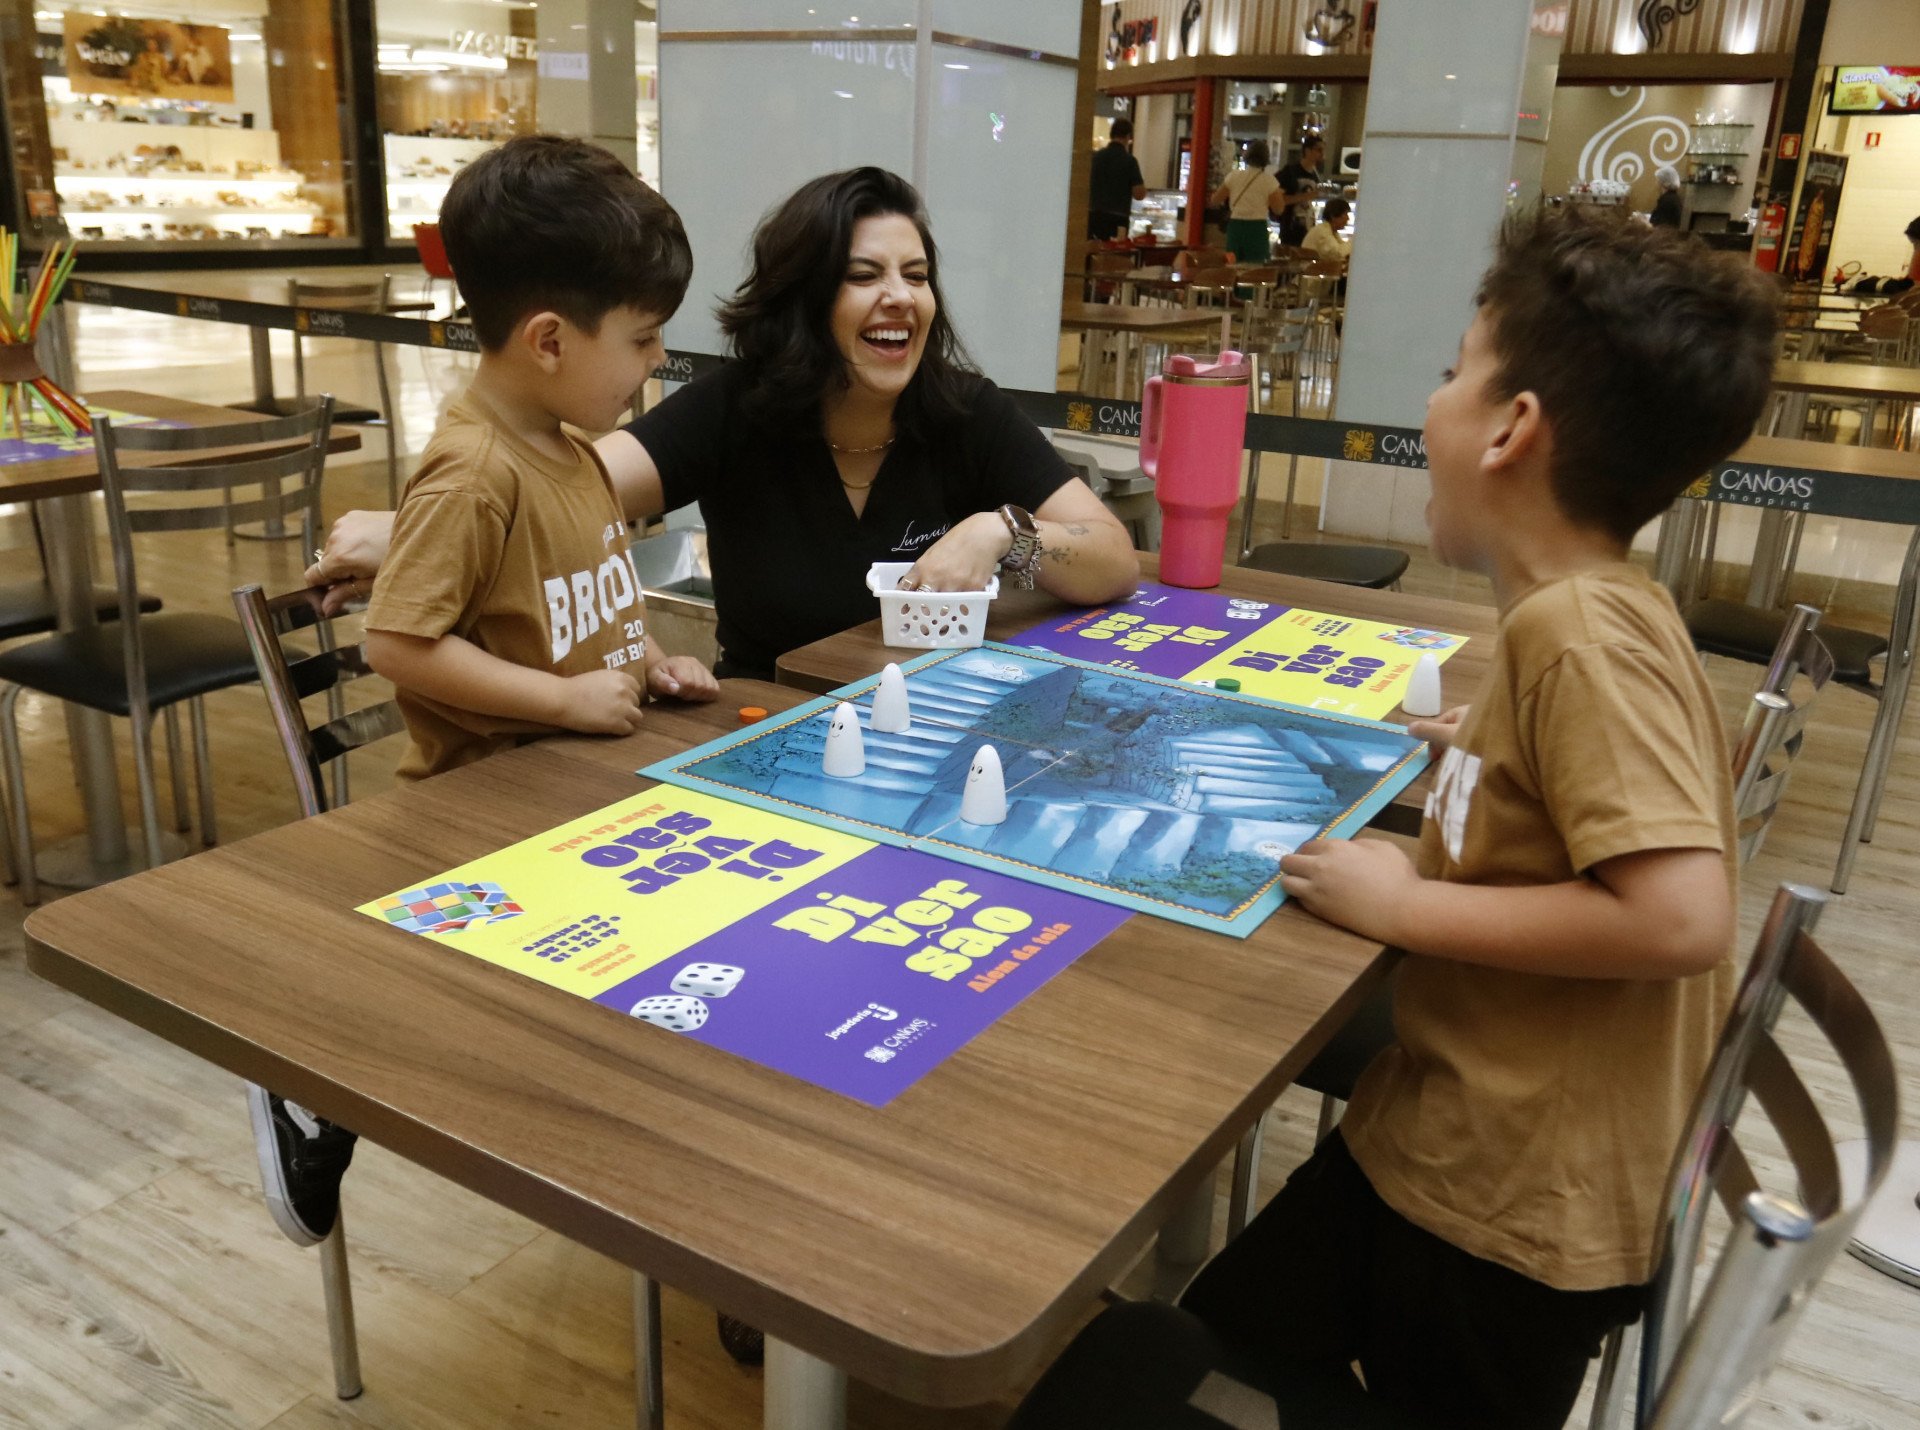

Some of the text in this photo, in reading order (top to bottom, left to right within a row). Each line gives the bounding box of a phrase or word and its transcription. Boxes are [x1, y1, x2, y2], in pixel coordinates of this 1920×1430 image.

[1098, 405, 1142, 426] CANO
[1098, 426, 1140, 436] shopp
[1380, 456, 1428, 467] shopp
[1719, 468, 1814, 498] CANOAS
[1717, 492, 1811, 510] shopping
[1114, 624, 1181, 652] ver
[1169, 626, 1230, 646] Di
[603, 647, 628, 670] THE
[1230, 650, 1291, 672] Di
[1283, 645, 1345, 673] ver
[621, 835, 754, 895] ver
[719, 838, 824, 883] Di
[772, 891, 887, 943] Di
[851, 879, 981, 947] ver
[1011, 944, 1041, 961] da
[883, 1017, 929, 1048] CANOAS
